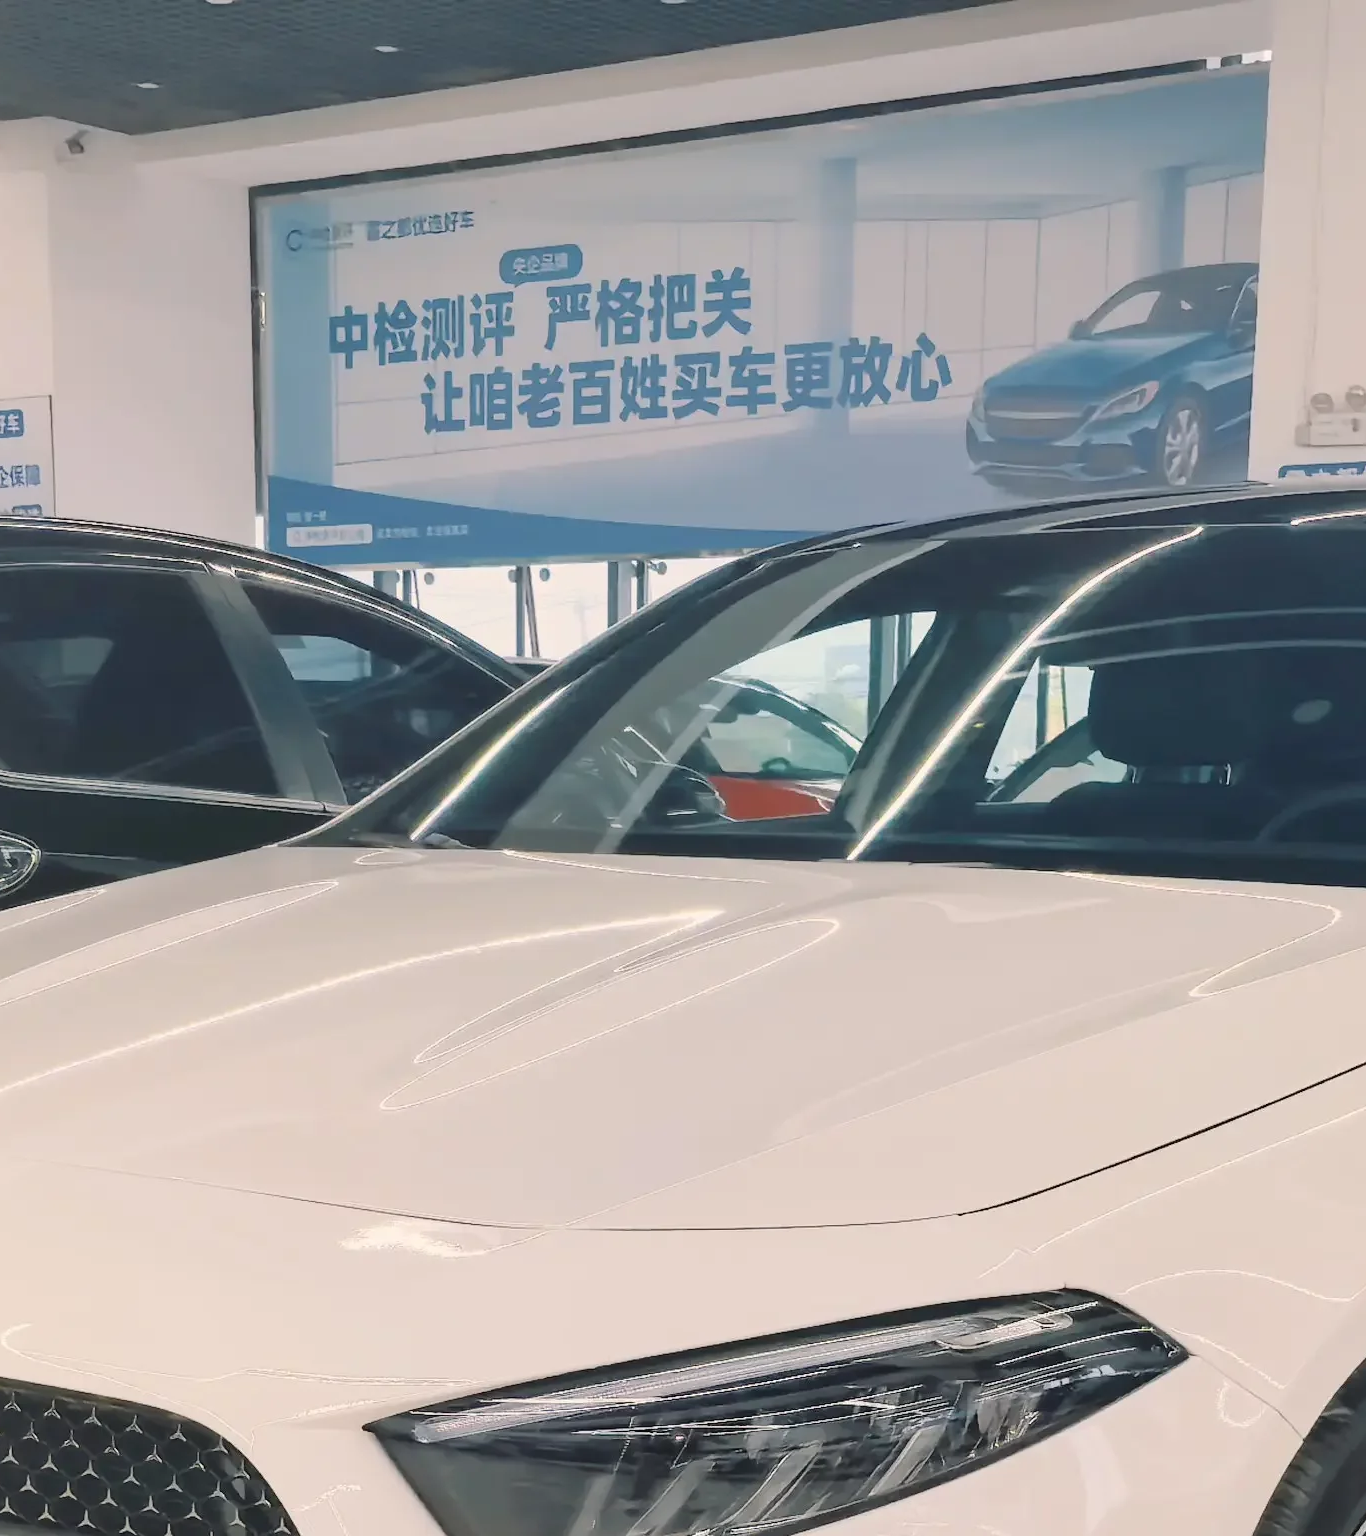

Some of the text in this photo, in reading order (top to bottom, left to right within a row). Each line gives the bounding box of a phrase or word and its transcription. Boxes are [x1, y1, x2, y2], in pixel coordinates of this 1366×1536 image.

[329, 267, 753, 369] 中检测评 严格把关
[420, 331, 952, 434] 让咱老百姓买车更放心
